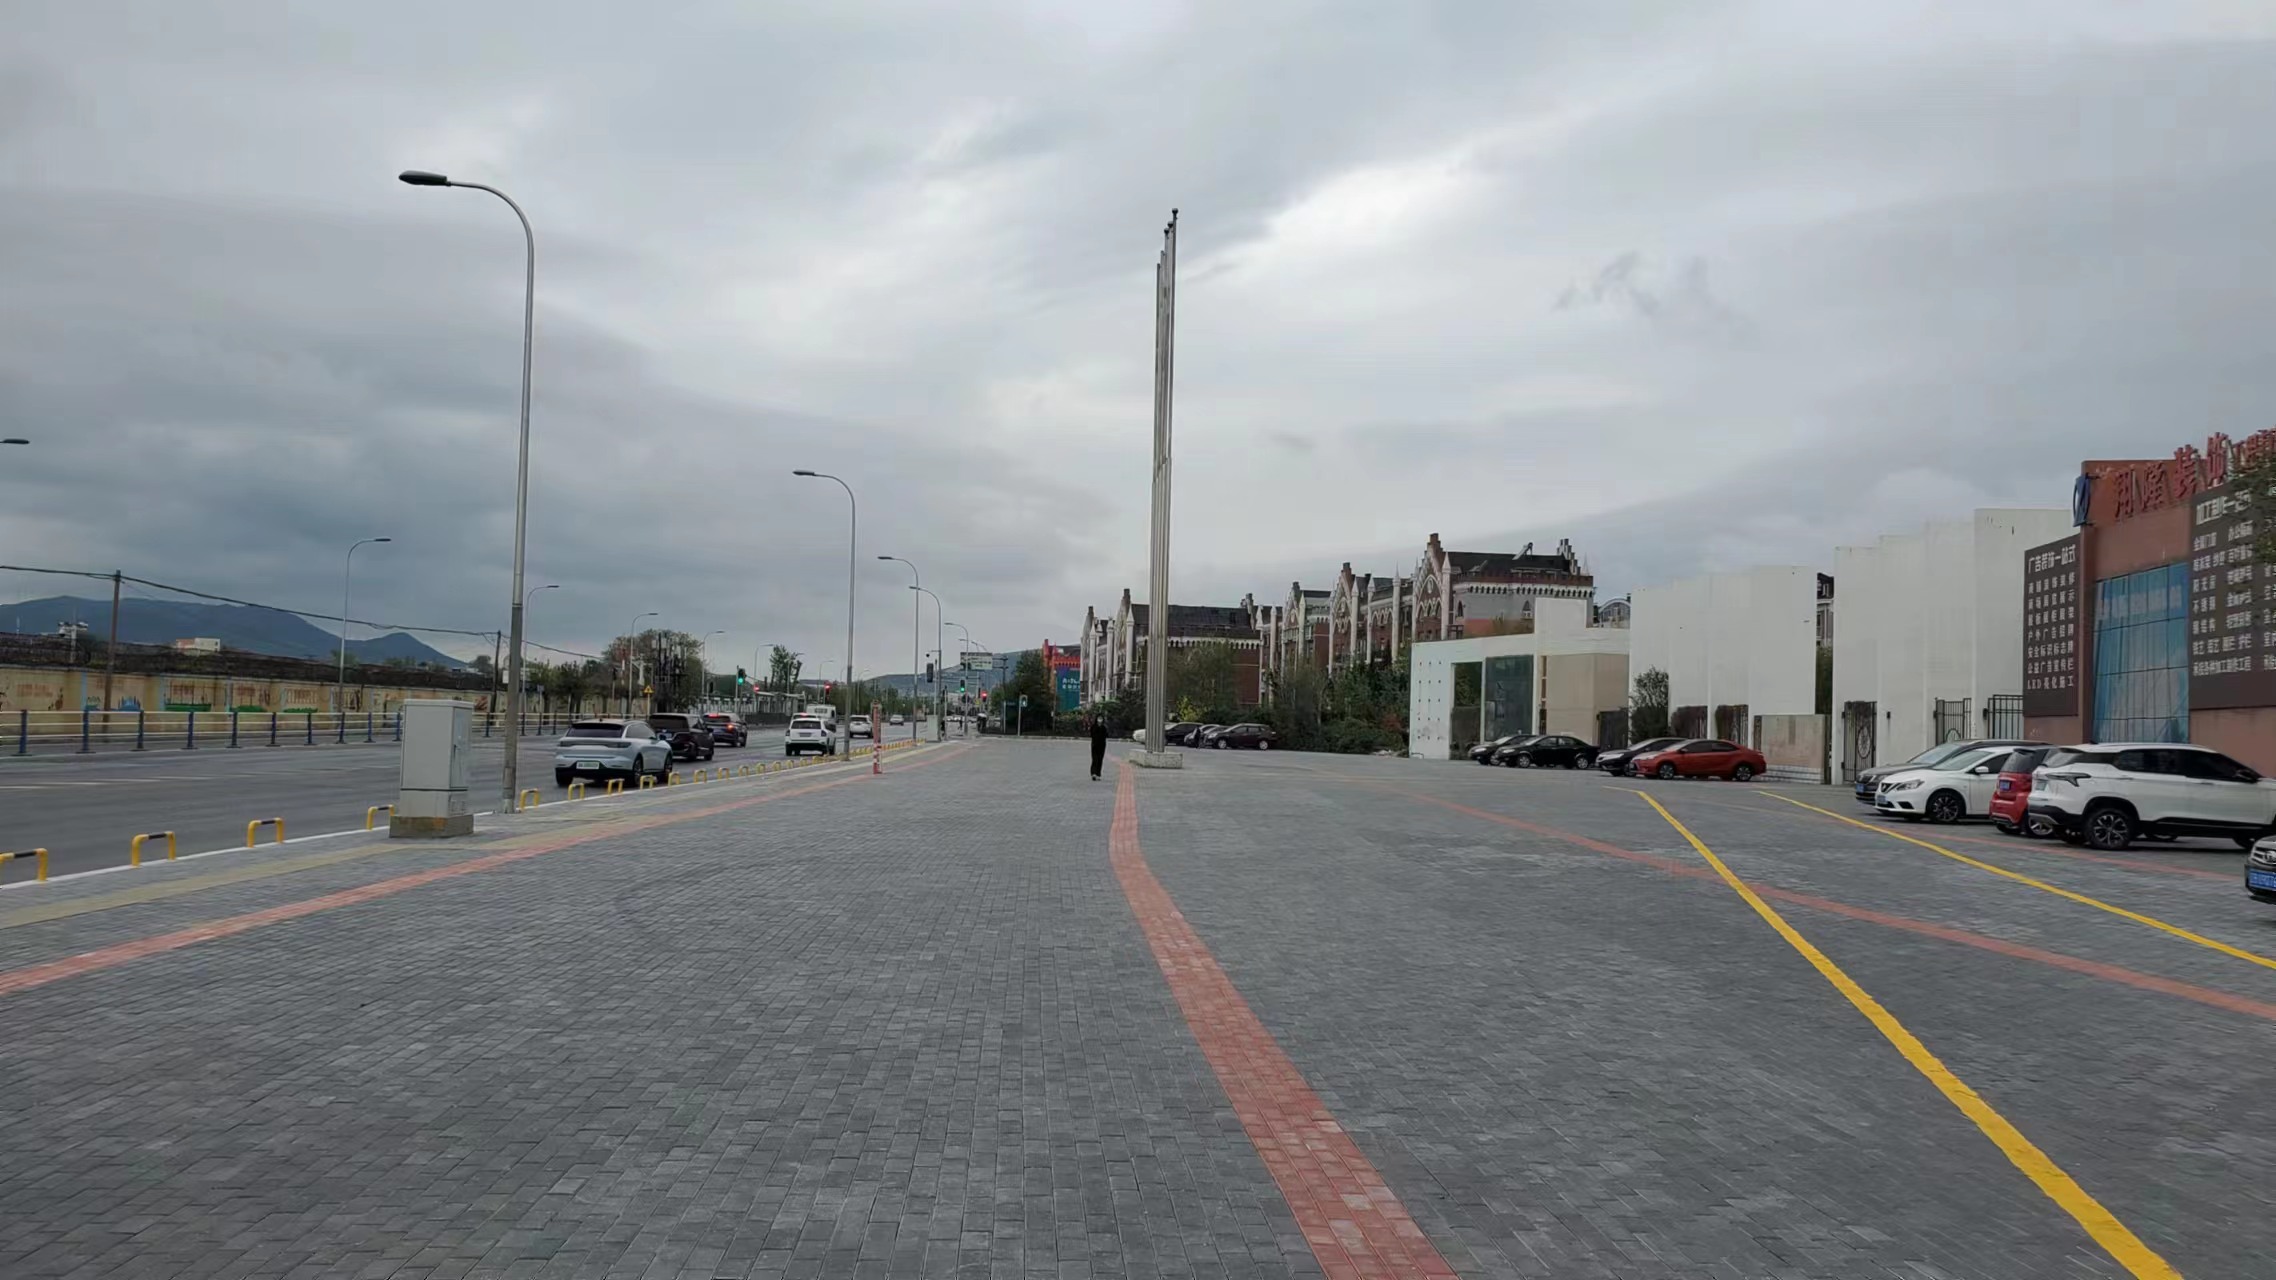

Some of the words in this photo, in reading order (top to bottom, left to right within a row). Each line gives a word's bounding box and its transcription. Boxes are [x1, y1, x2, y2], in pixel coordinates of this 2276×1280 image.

[2028, 544, 2077, 574] 广告装饰一站式
[2028, 623, 2074, 643] 户外广告招牌
[2028, 640, 2074, 659] 安全标识标志牌
